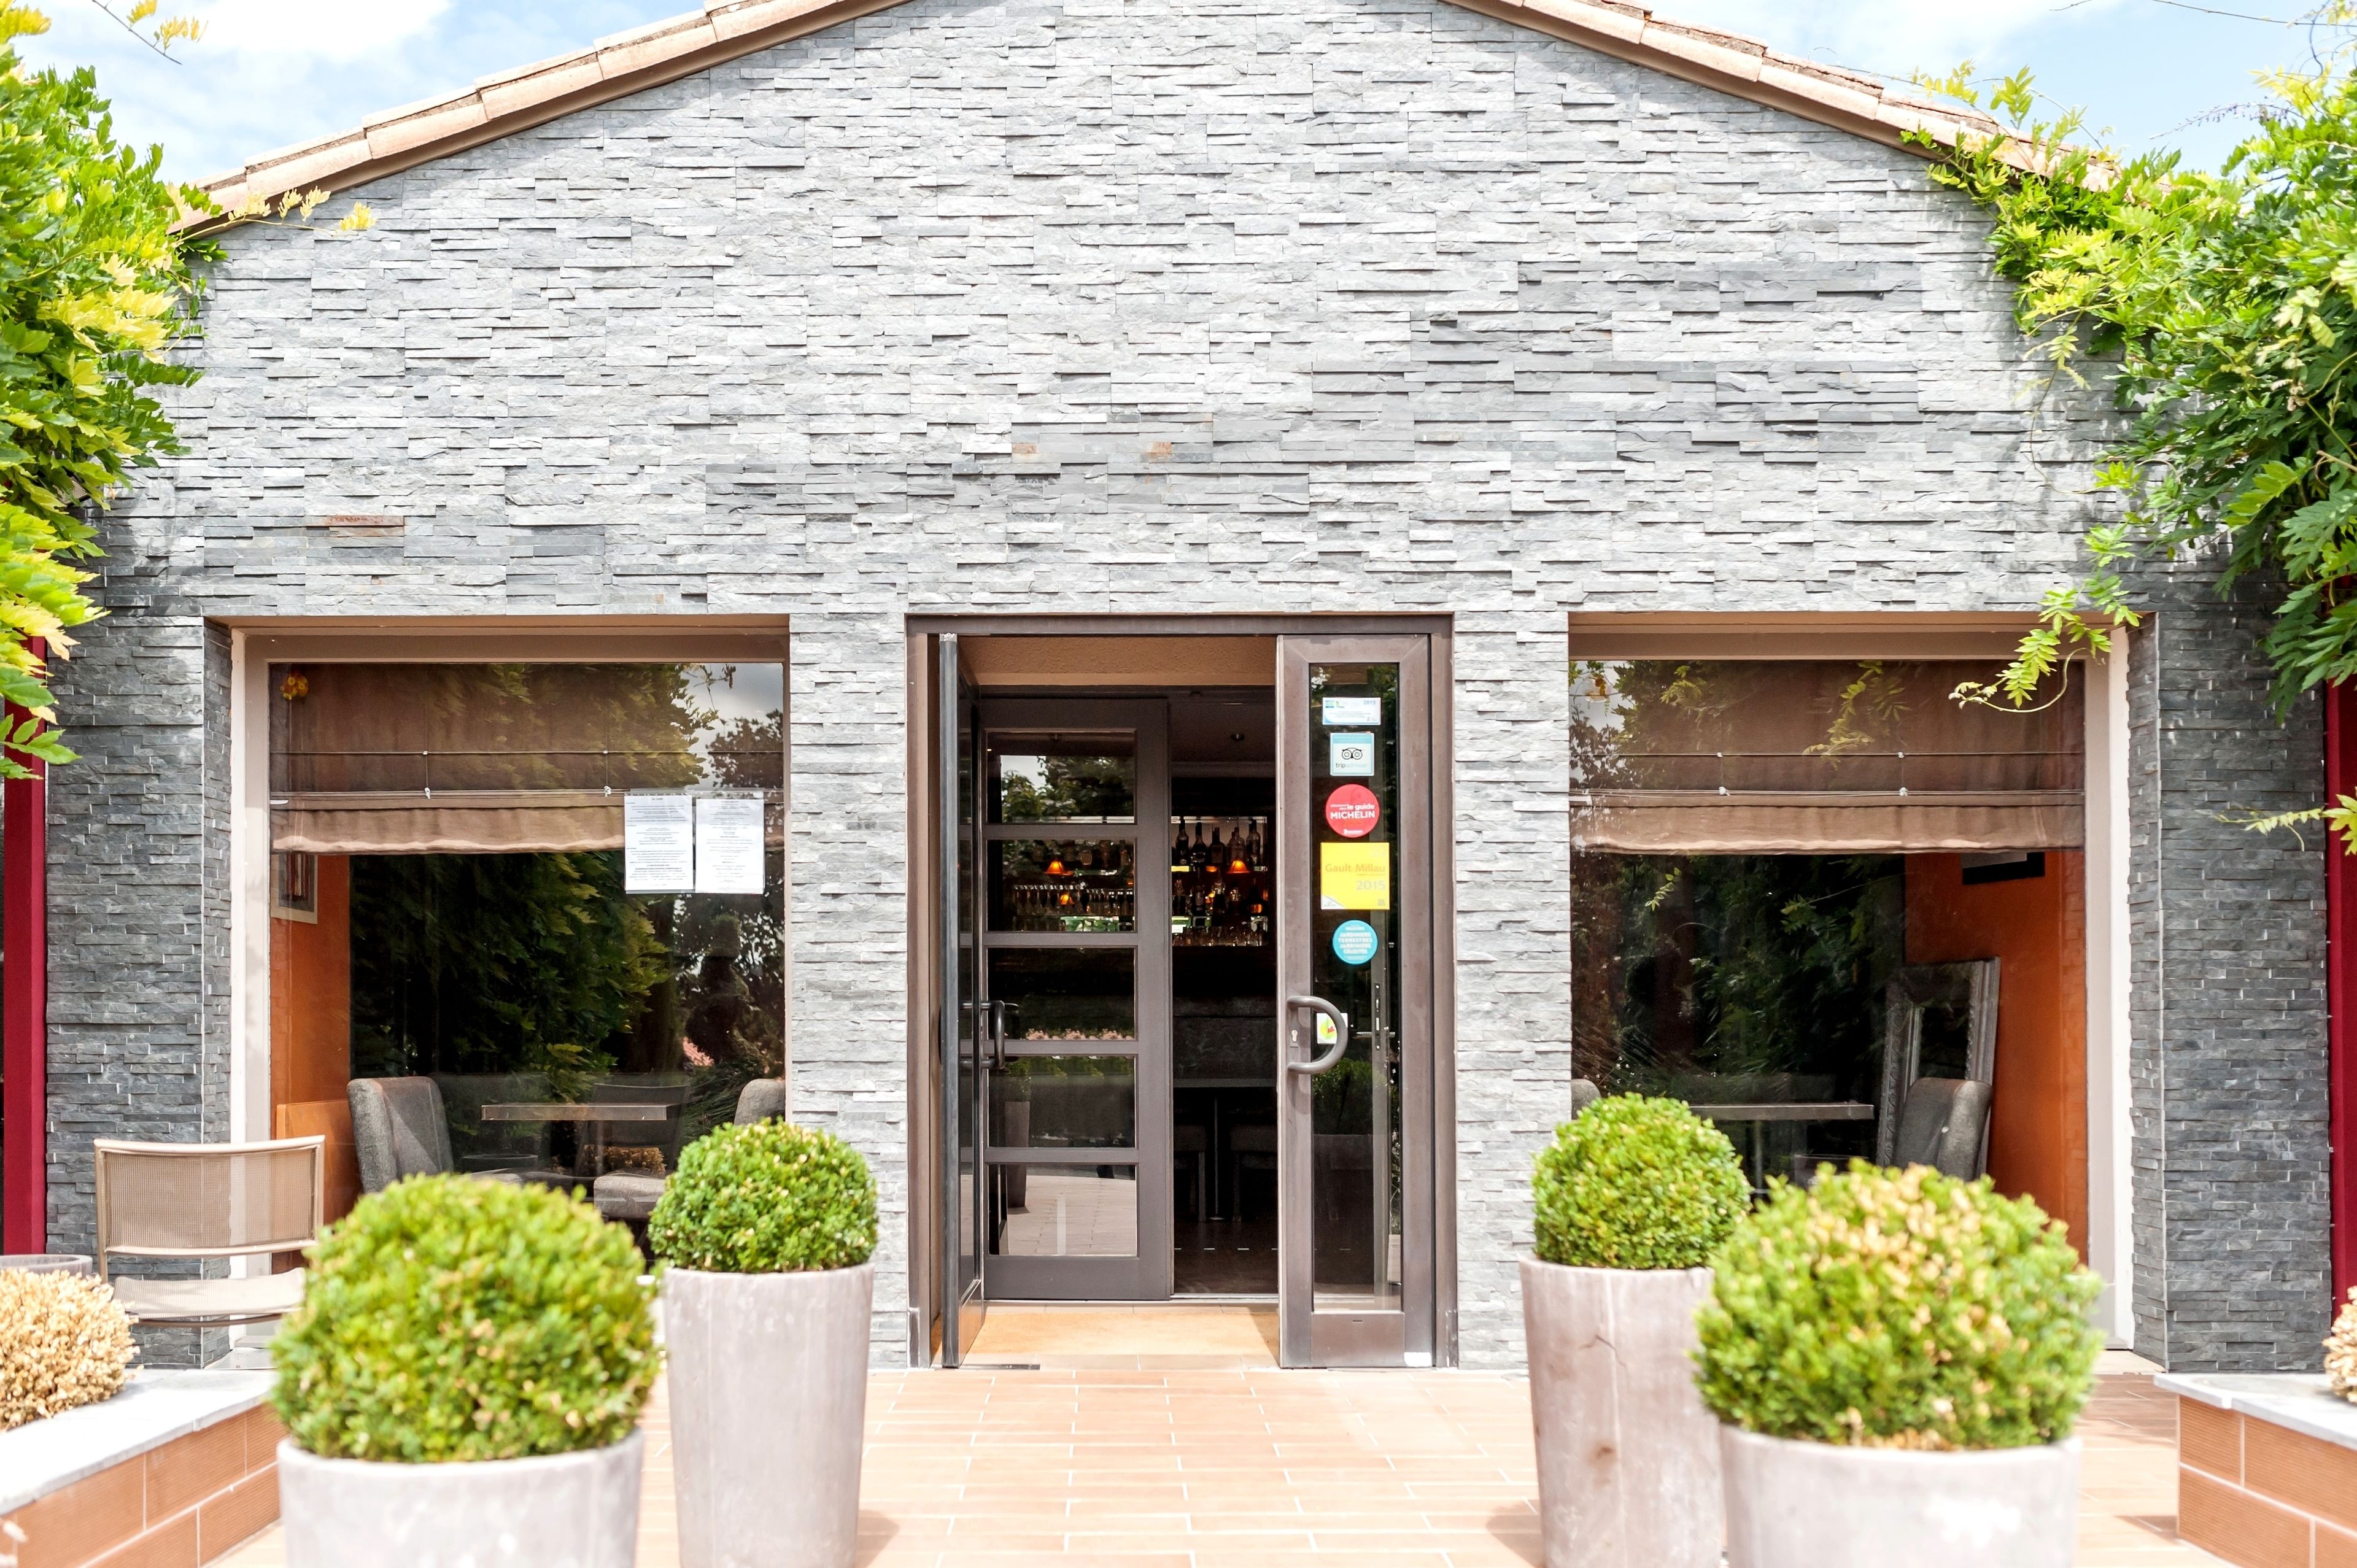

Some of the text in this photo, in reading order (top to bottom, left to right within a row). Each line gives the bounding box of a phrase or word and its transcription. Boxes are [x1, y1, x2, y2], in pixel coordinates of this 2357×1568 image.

[1330, 811, 1375, 819] MICHELIN
[1325, 863, 1385, 872] Gault Millau
[1357, 880, 1385, 890] 2015
